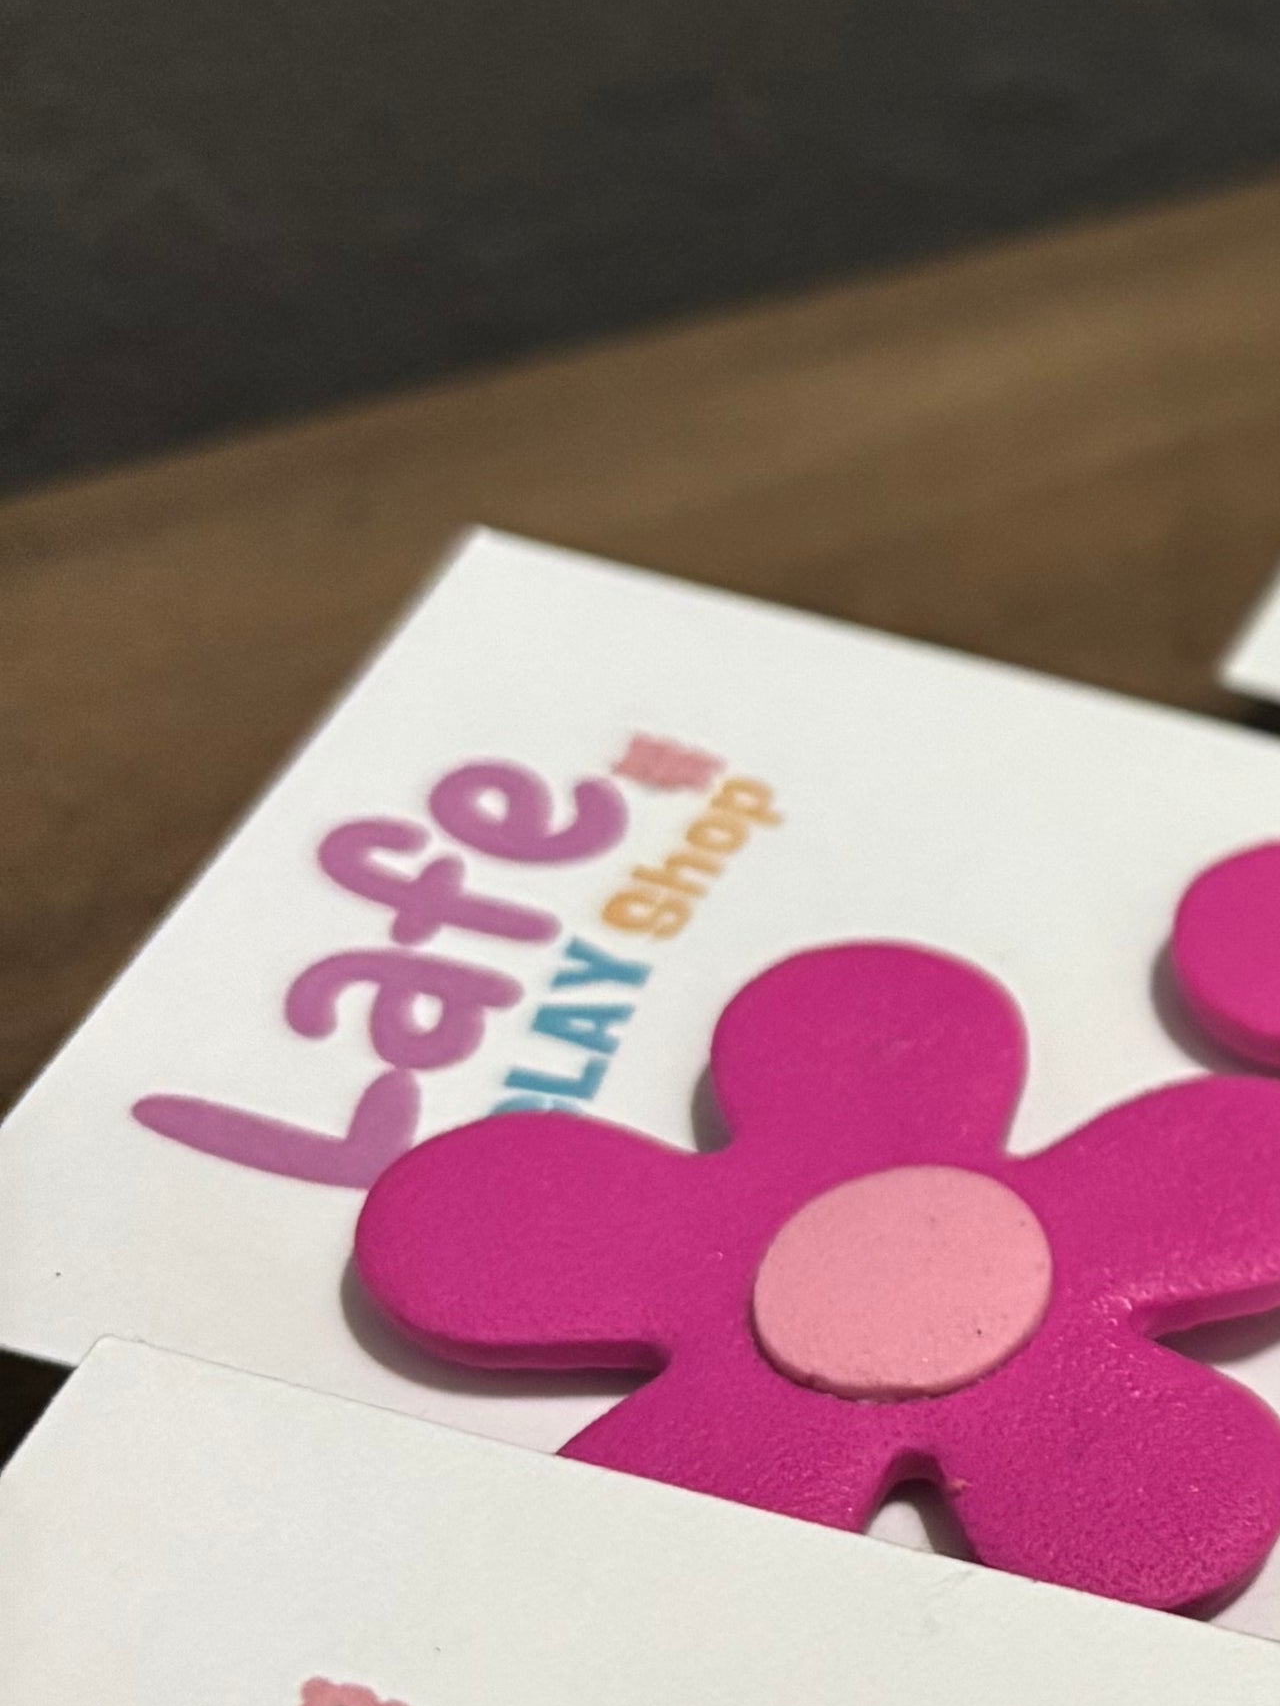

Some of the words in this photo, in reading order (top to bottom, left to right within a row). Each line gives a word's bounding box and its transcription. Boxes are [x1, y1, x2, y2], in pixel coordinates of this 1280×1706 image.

[129, 758, 629, 1190] Lafe
[485, 935, 653, 1115] LAY
[598, 776, 783, 941] Shop
